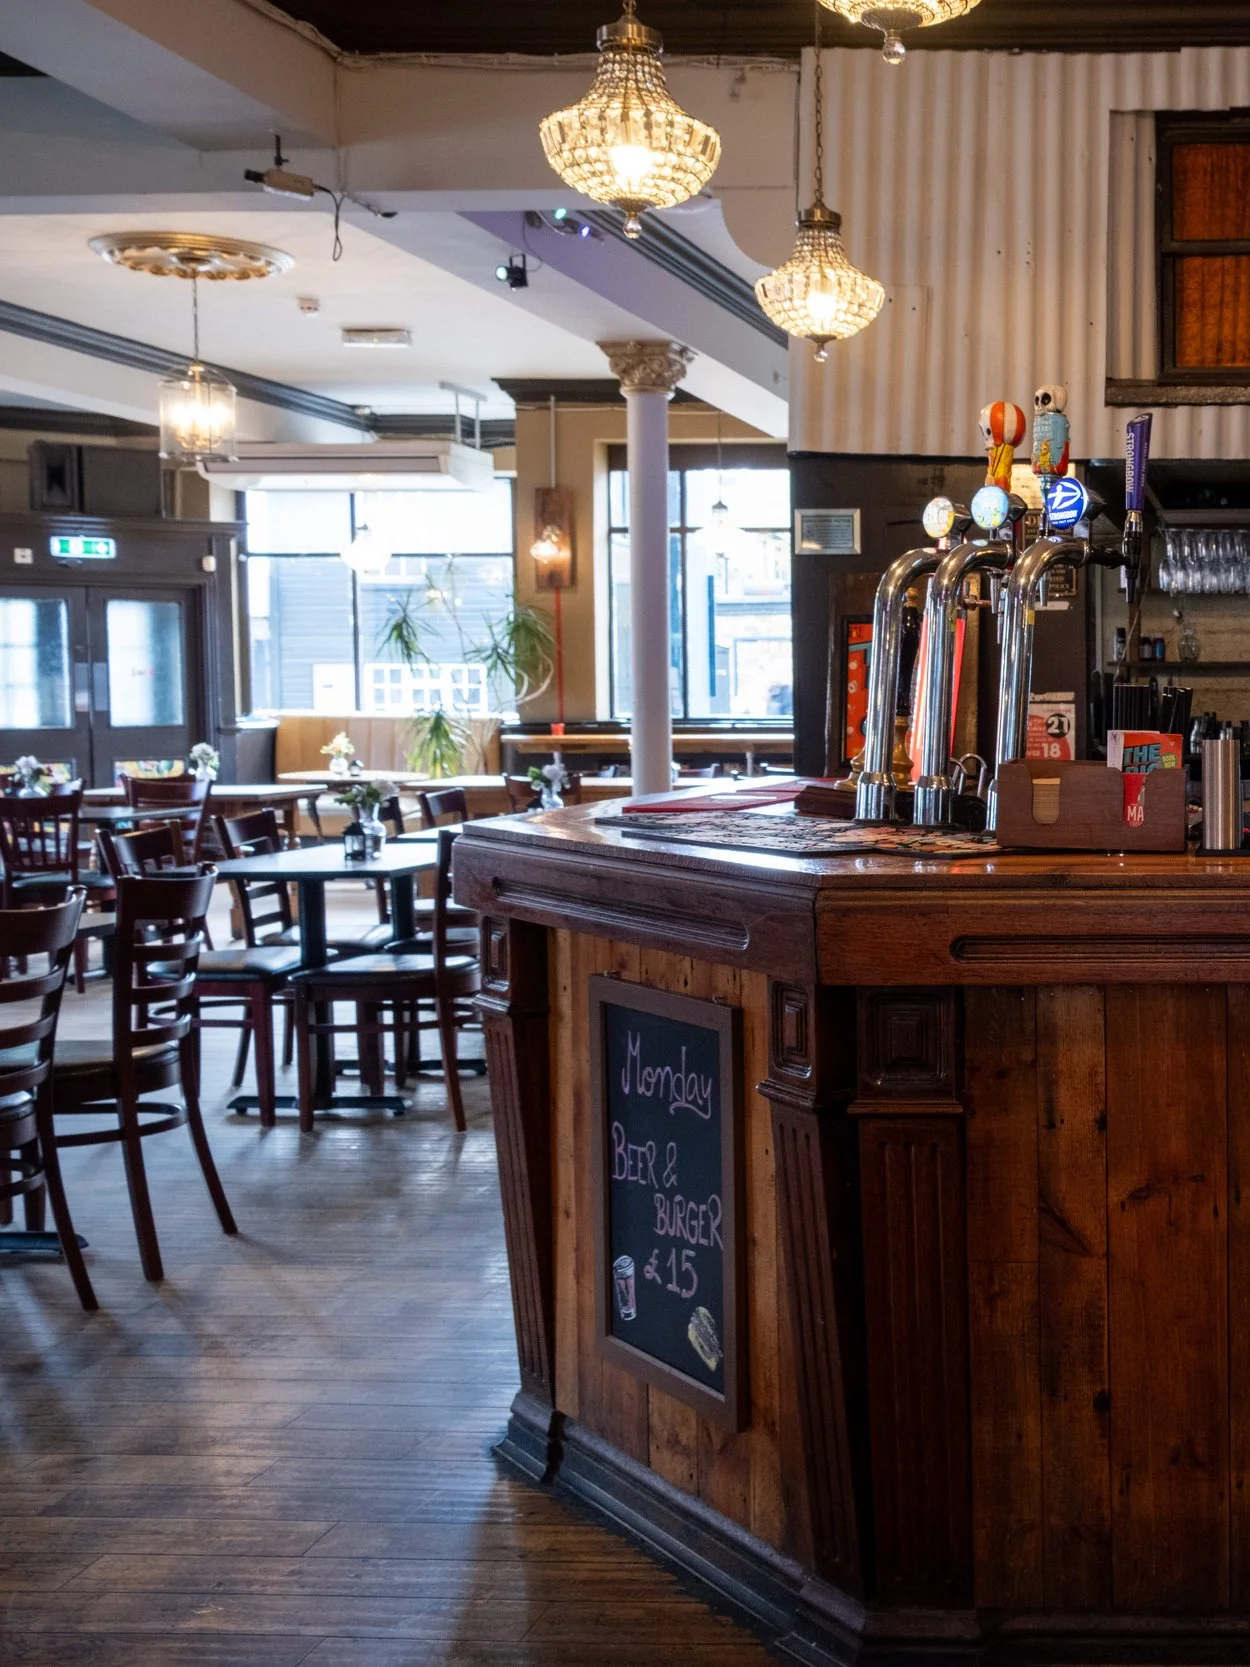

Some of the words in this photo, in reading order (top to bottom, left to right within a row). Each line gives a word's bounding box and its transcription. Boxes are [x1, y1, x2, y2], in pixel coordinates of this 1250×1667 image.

[1125, 432, 1135, 493] STRONGBOW
[1041, 742, 1062, 759] 18
[1047, 715, 1069, 734] 21
[1123, 744, 1161, 767] THE
[621, 1029, 713, 1119] Monday
[611, 1120, 659, 1189] BEER
[662, 1141, 678, 1189] &
[653, 1192, 724, 1250] BURGER
[643, 1247, 698, 1299] £15
